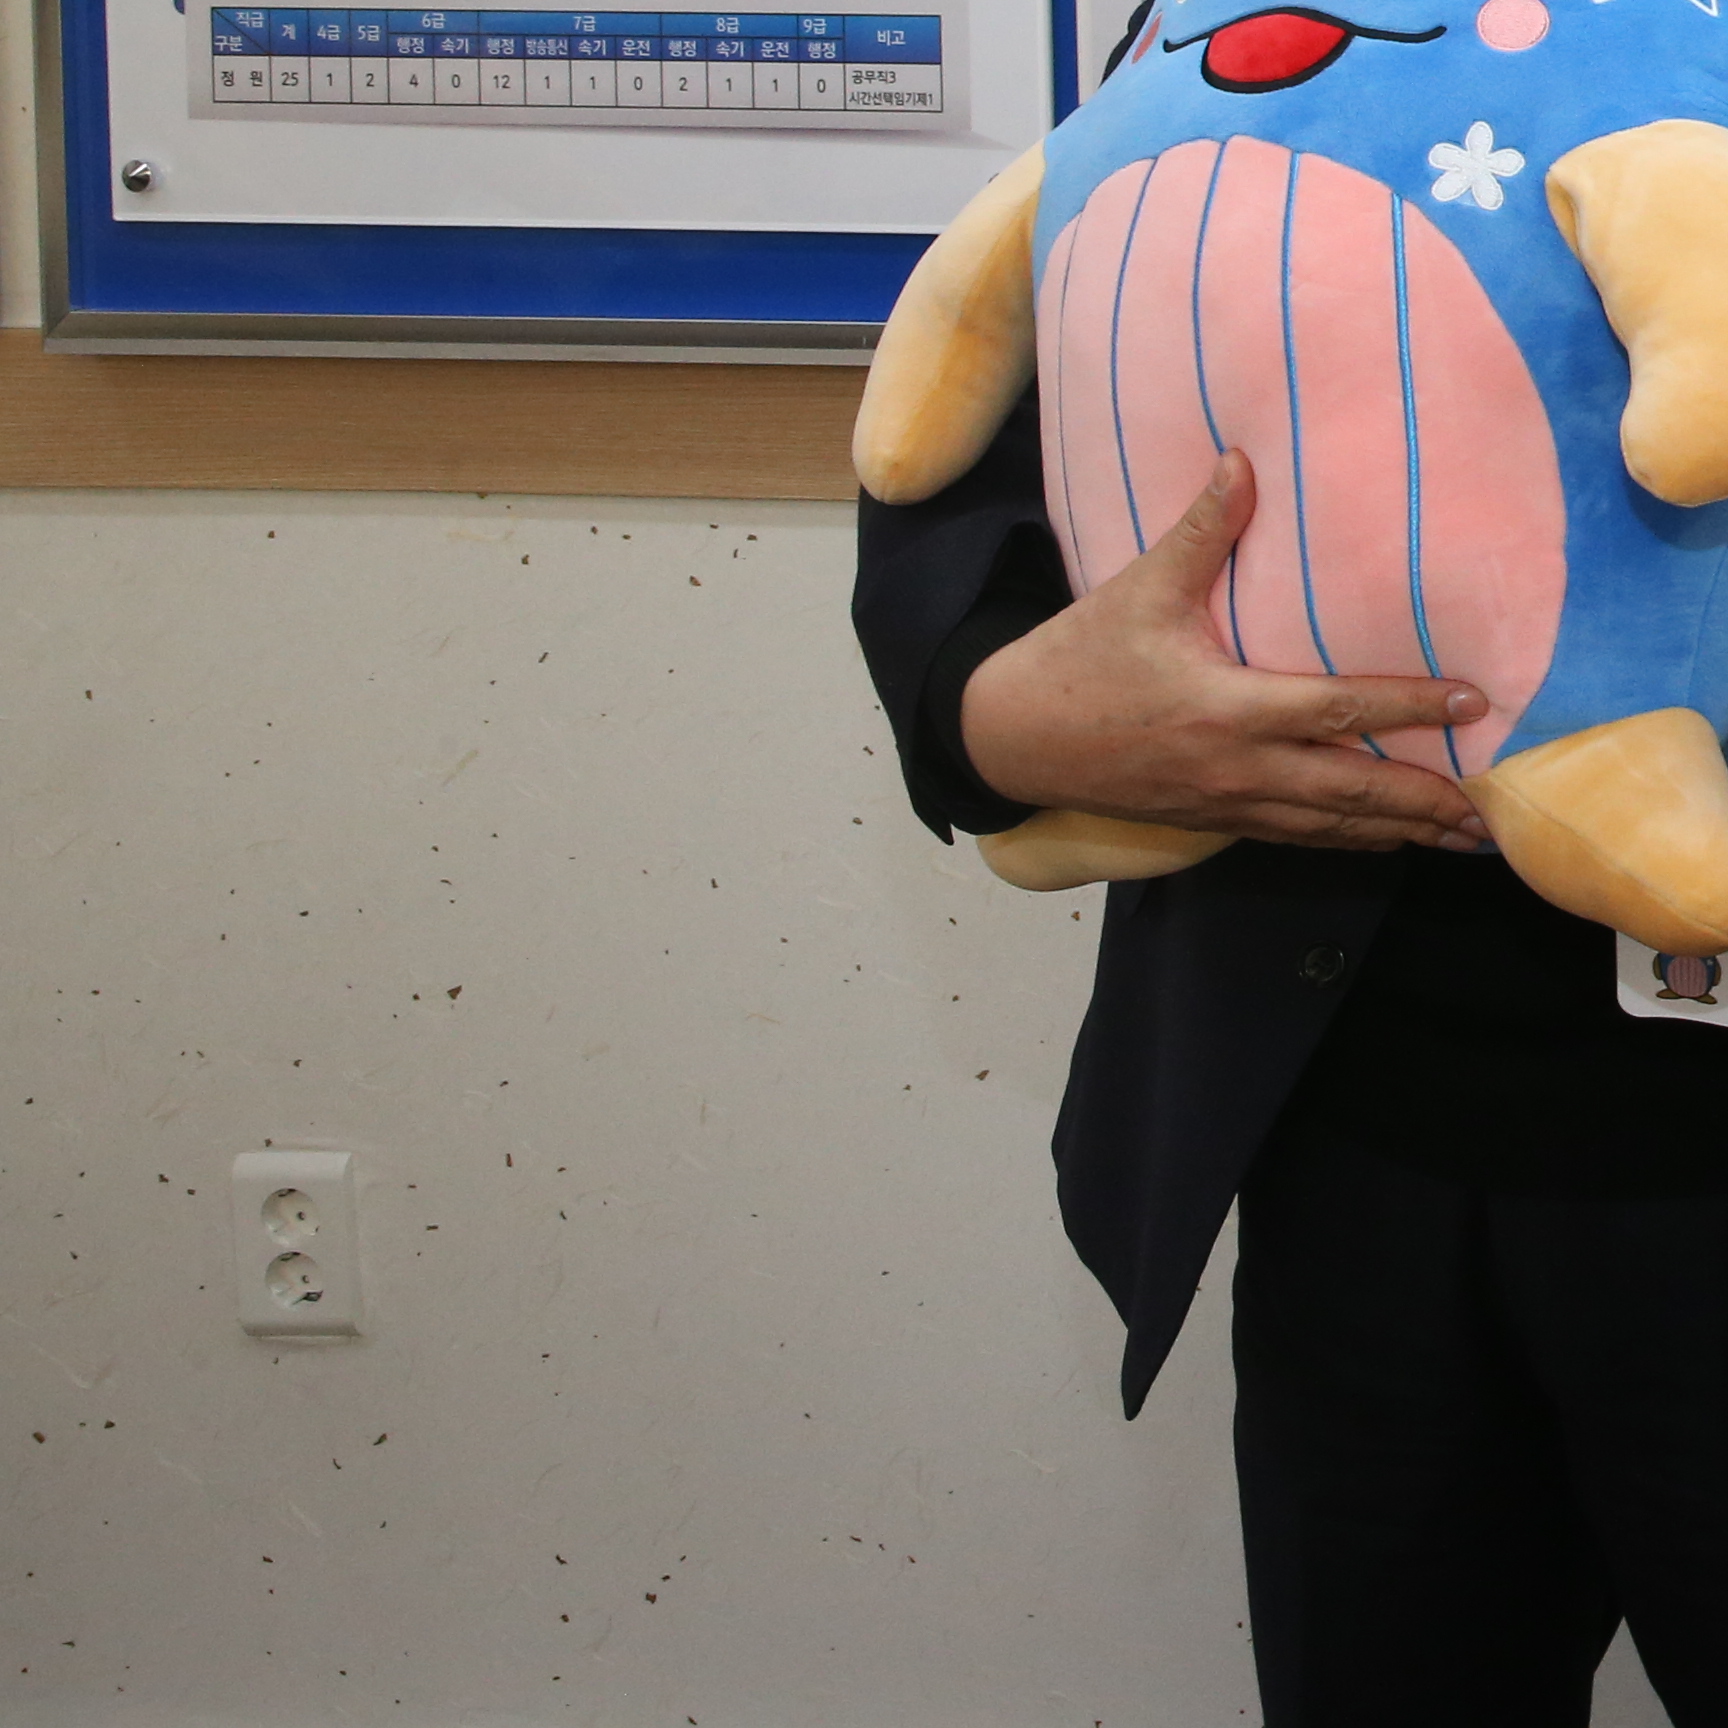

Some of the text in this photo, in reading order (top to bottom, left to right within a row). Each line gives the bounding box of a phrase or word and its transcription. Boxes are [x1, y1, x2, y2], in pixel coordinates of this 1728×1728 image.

[236, 11, 265, 28] 직급
[421, 12, 446, 29] 6급
[573, 15, 597, 32] 7급
[716, 17, 739, 34] 8급
[803, 18, 827, 35] 9급
[281, 24, 296, 40] 계
[316, 24, 341, 41] 4급
[357, 25, 380, 42] 5급
[877, 29, 906, 47] 비고
[214, 35, 243, 52] 구분
[280, 71, 299, 87] 25
[851, 70, 897, 85] 공무직3
